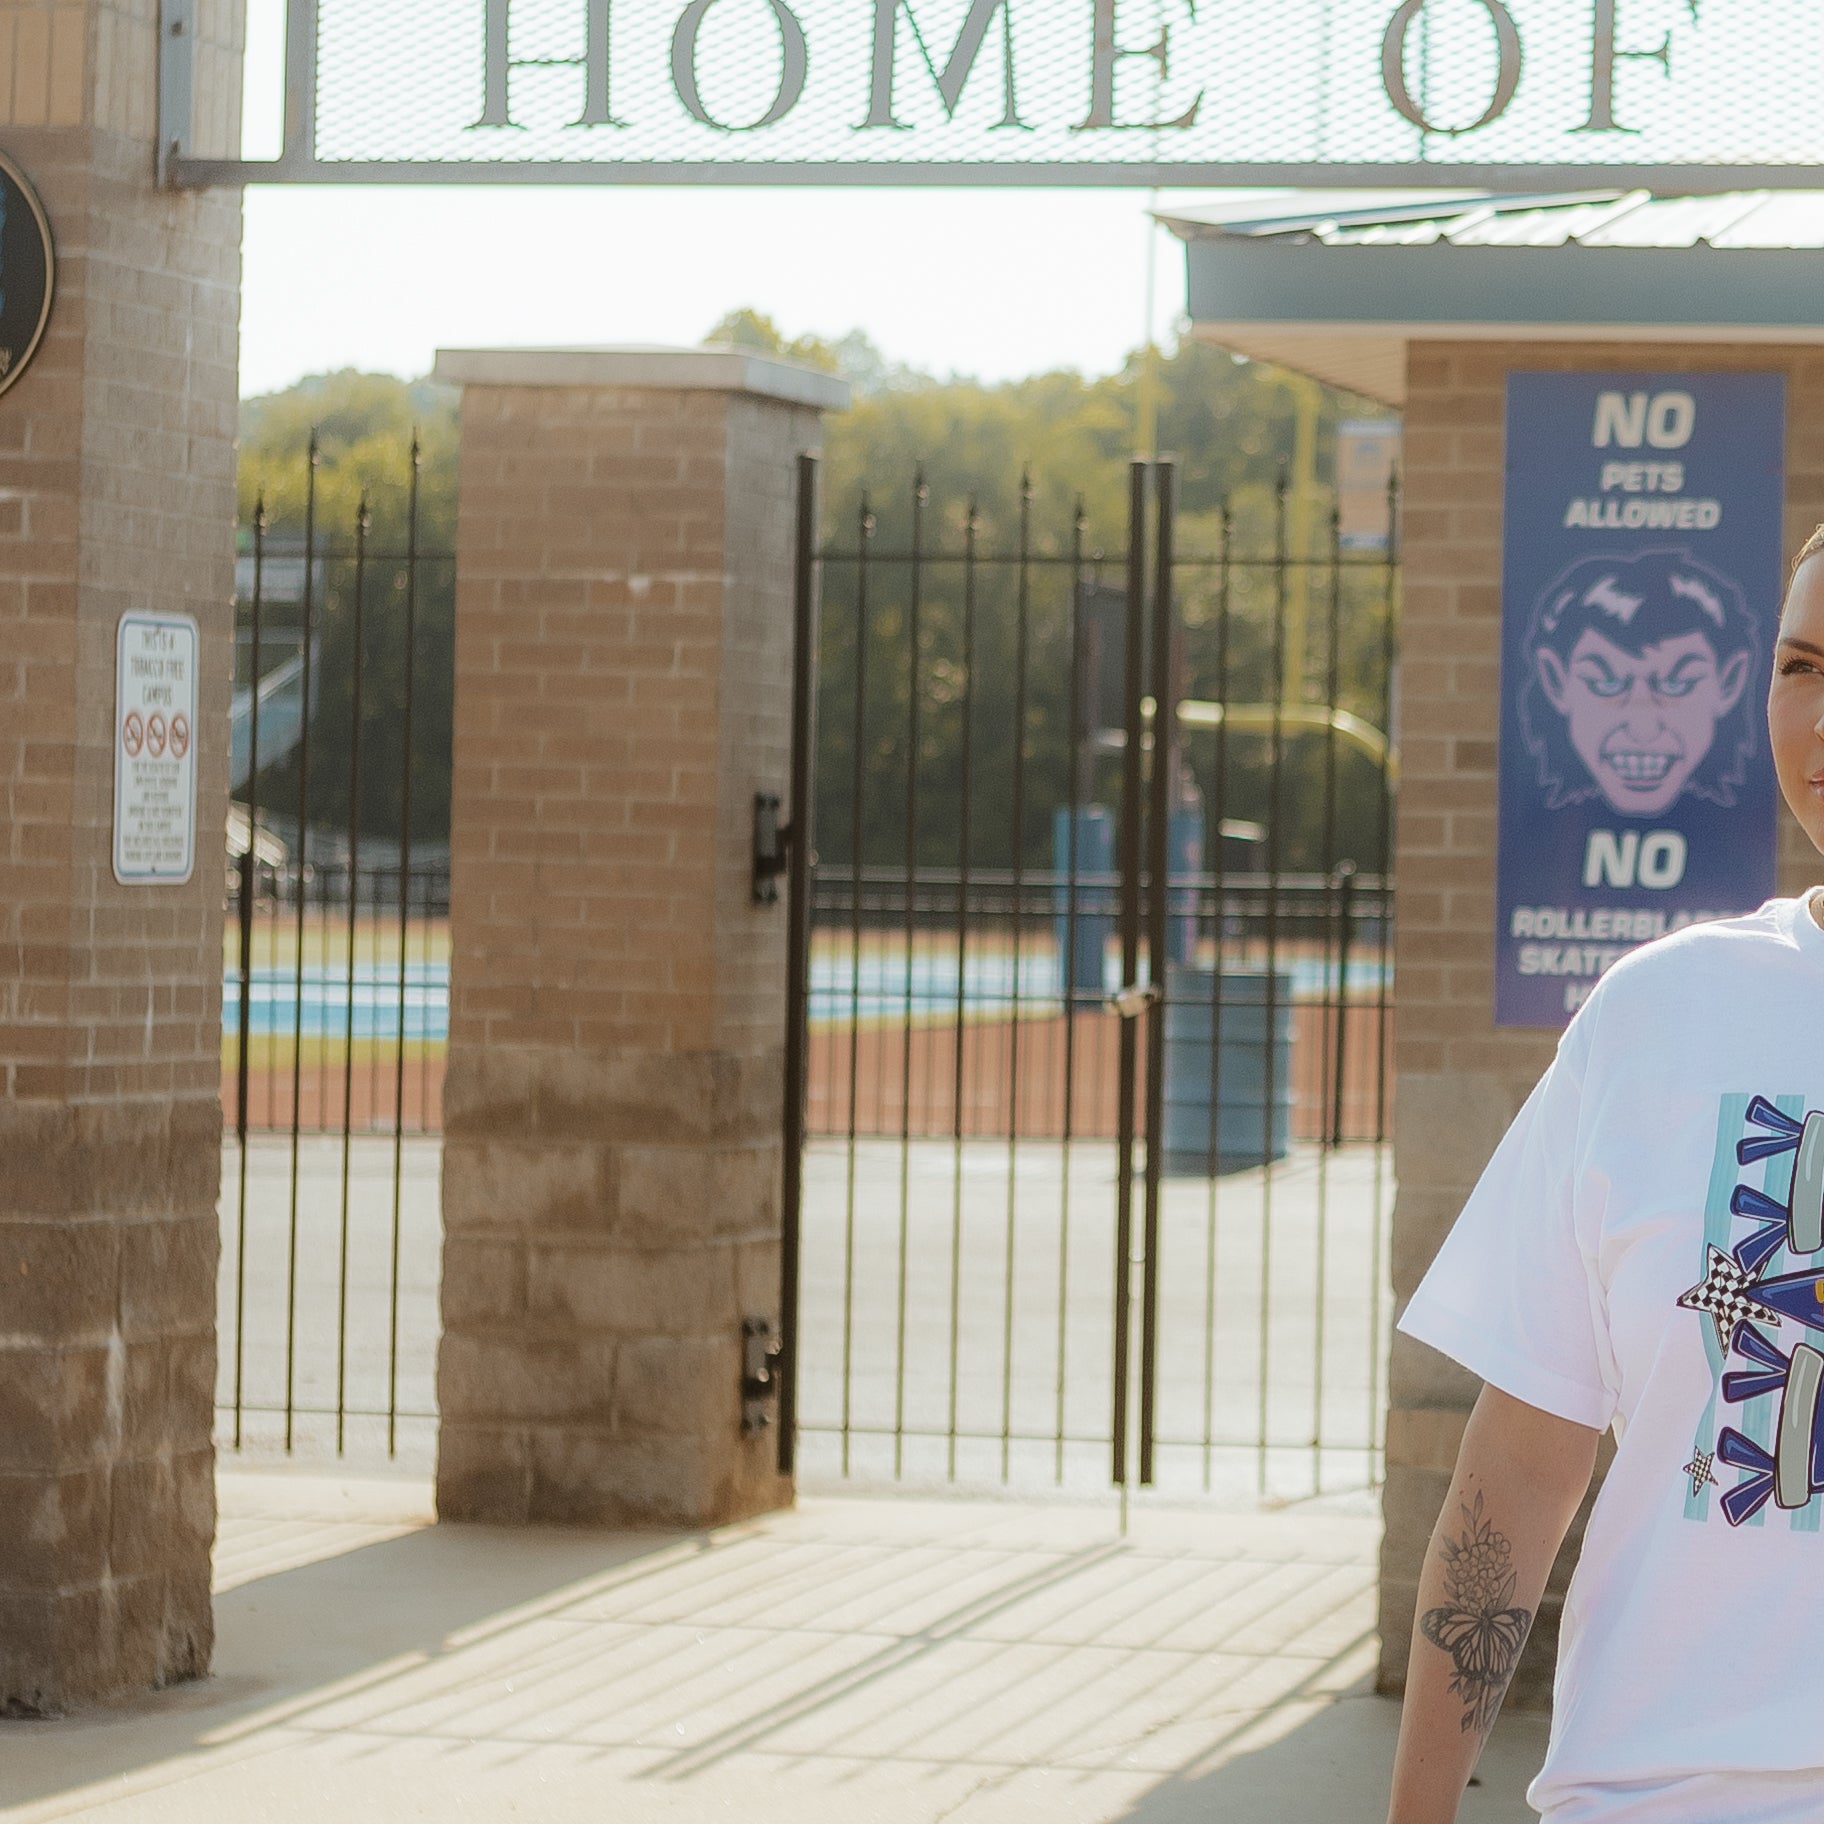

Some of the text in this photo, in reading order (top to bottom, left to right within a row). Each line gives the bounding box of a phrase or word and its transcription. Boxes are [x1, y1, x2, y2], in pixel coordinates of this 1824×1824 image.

[1592, 390, 1697, 449] NO
[1601, 461, 1684, 493] PETS
[1564, 498, 1722, 530] ALLOWED
[1583, 829, 1688, 890] NO
